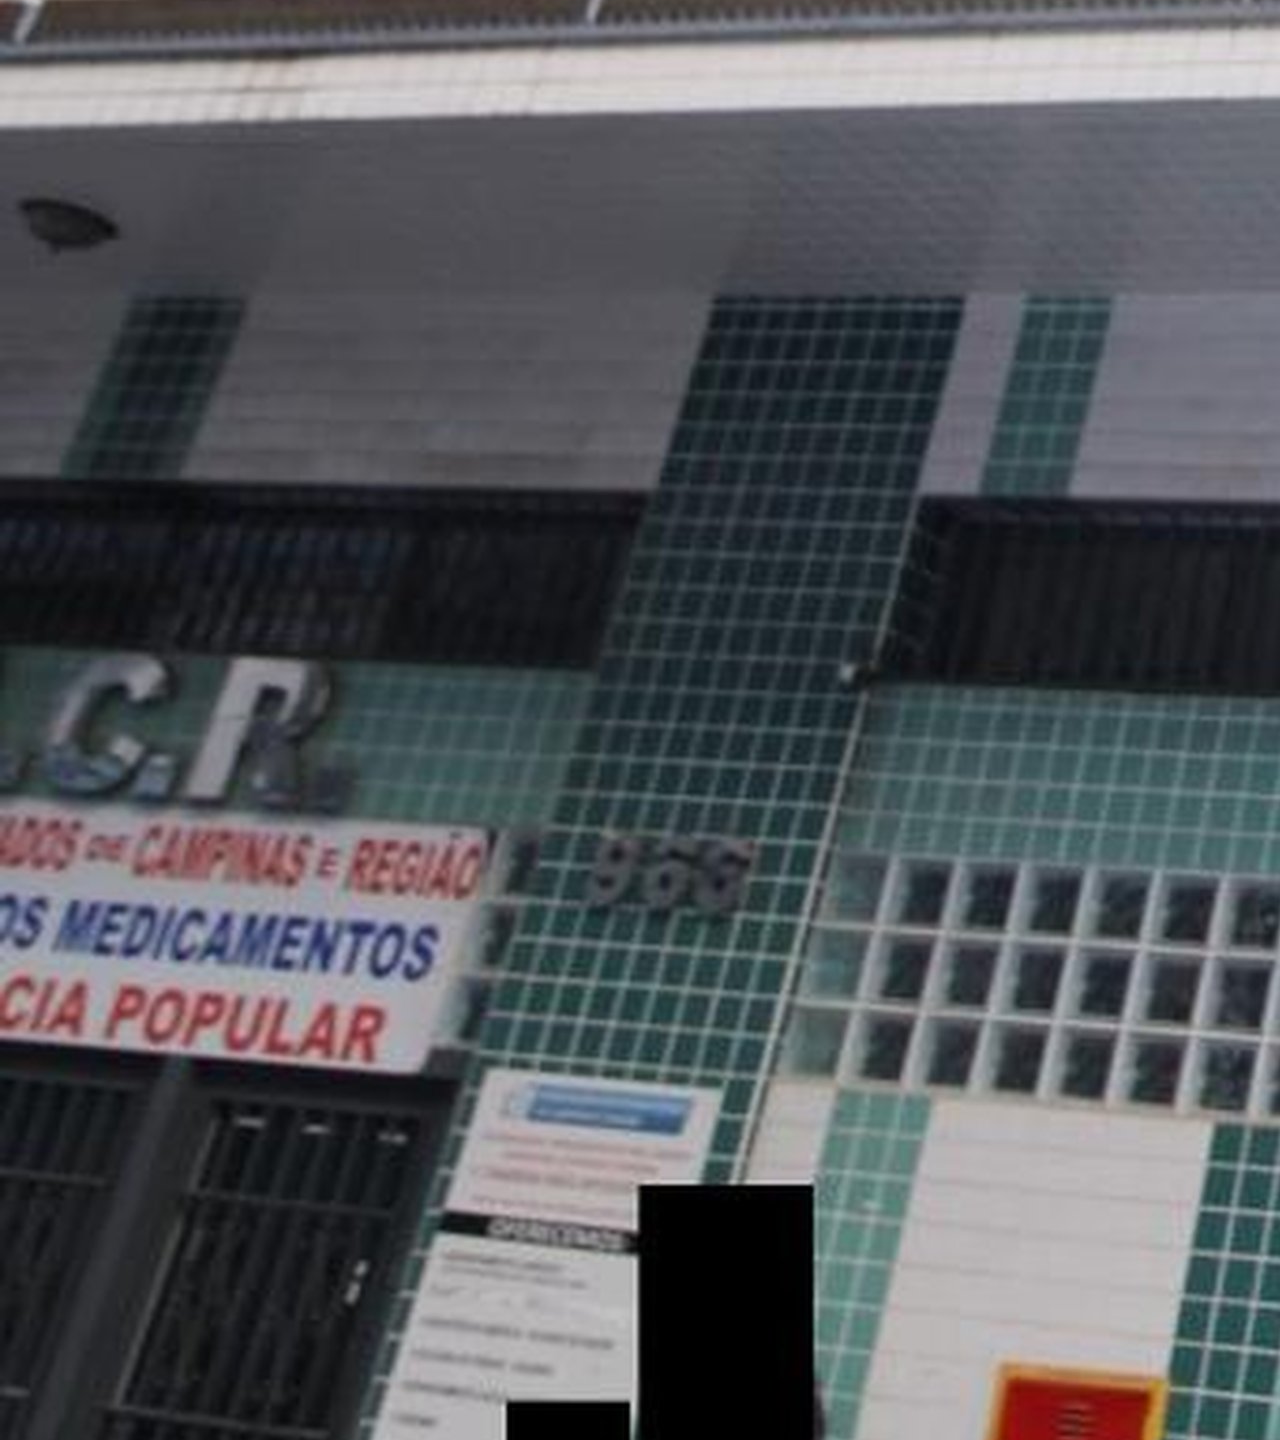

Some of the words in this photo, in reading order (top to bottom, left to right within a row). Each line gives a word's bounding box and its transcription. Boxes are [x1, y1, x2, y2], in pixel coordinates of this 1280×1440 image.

[132, 824, 312, 888] CAMPINAS
[52, 899, 440, 982] MEDICAMENTOS
[104, 982, 388, 1063] POPULAR
